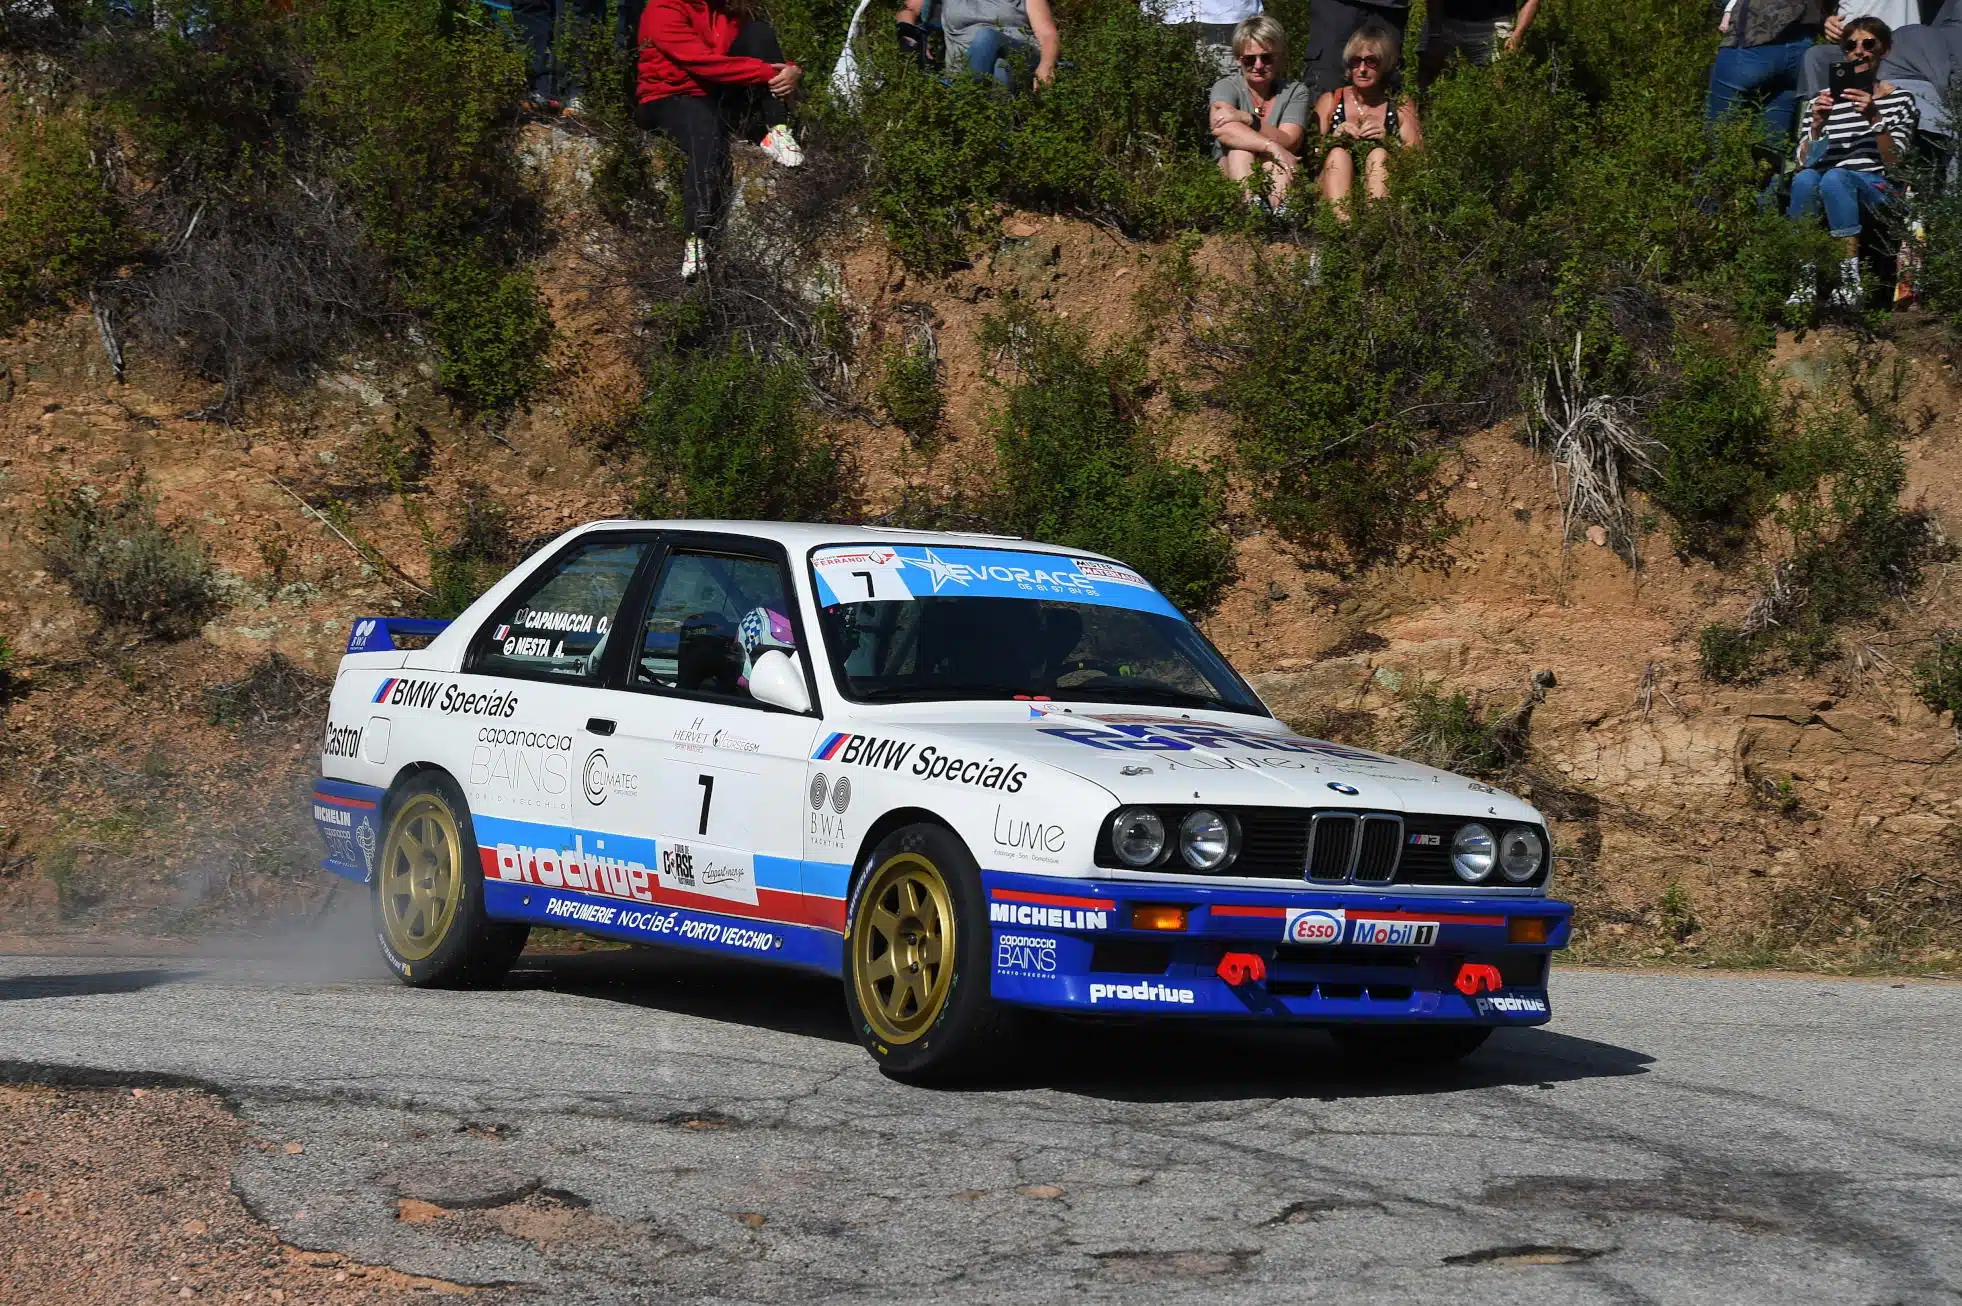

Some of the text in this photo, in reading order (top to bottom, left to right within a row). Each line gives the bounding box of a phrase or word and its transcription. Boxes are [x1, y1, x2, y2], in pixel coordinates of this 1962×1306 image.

[812, 557, 866, 567] FERRANDI
[852, 571, 875, 597] 7
[949, 563, 1095, 590] EVORACE
[524, 610, 608, 635] CAPANACCIA O.
[514, 636, 565, 658] NESTA A.
[391, 678, 519, 718] BMW Specials
[690, 716, 704, 730] H
[324, 721, 364, 759] Castrol
[478, 727, 573, 751] capanaccia
[673, 730, 711, 744] HERVET
[469, 745, 568, 794] BAINS
[841, 734, 1028, 793] BMW Specials
[592, 770, 639, 790] CLIMATEC
[314, 805, 351, 827] MICHELIN
[698, 774, 715, 835] 7
[810, 811, 846, 840] BWA
[546, 897, 617, 925] PARFUMERIE
[679, 925, 720, 942] PORTO
[720, 931, 773, 951] VECCHIO
[990, 902, 1107, 929] MICHELIN
[999, 934, 1057, 948] capanaccia
[1297, 920, 1335, 939] Esso
[1355, 922, 1431, 945] Mobil 1
[997, 944, 1057, 972] BAINS
[1089, 981, 1195, 1004] prodrive
[1476, 992, 1547, 1017] prodrive
